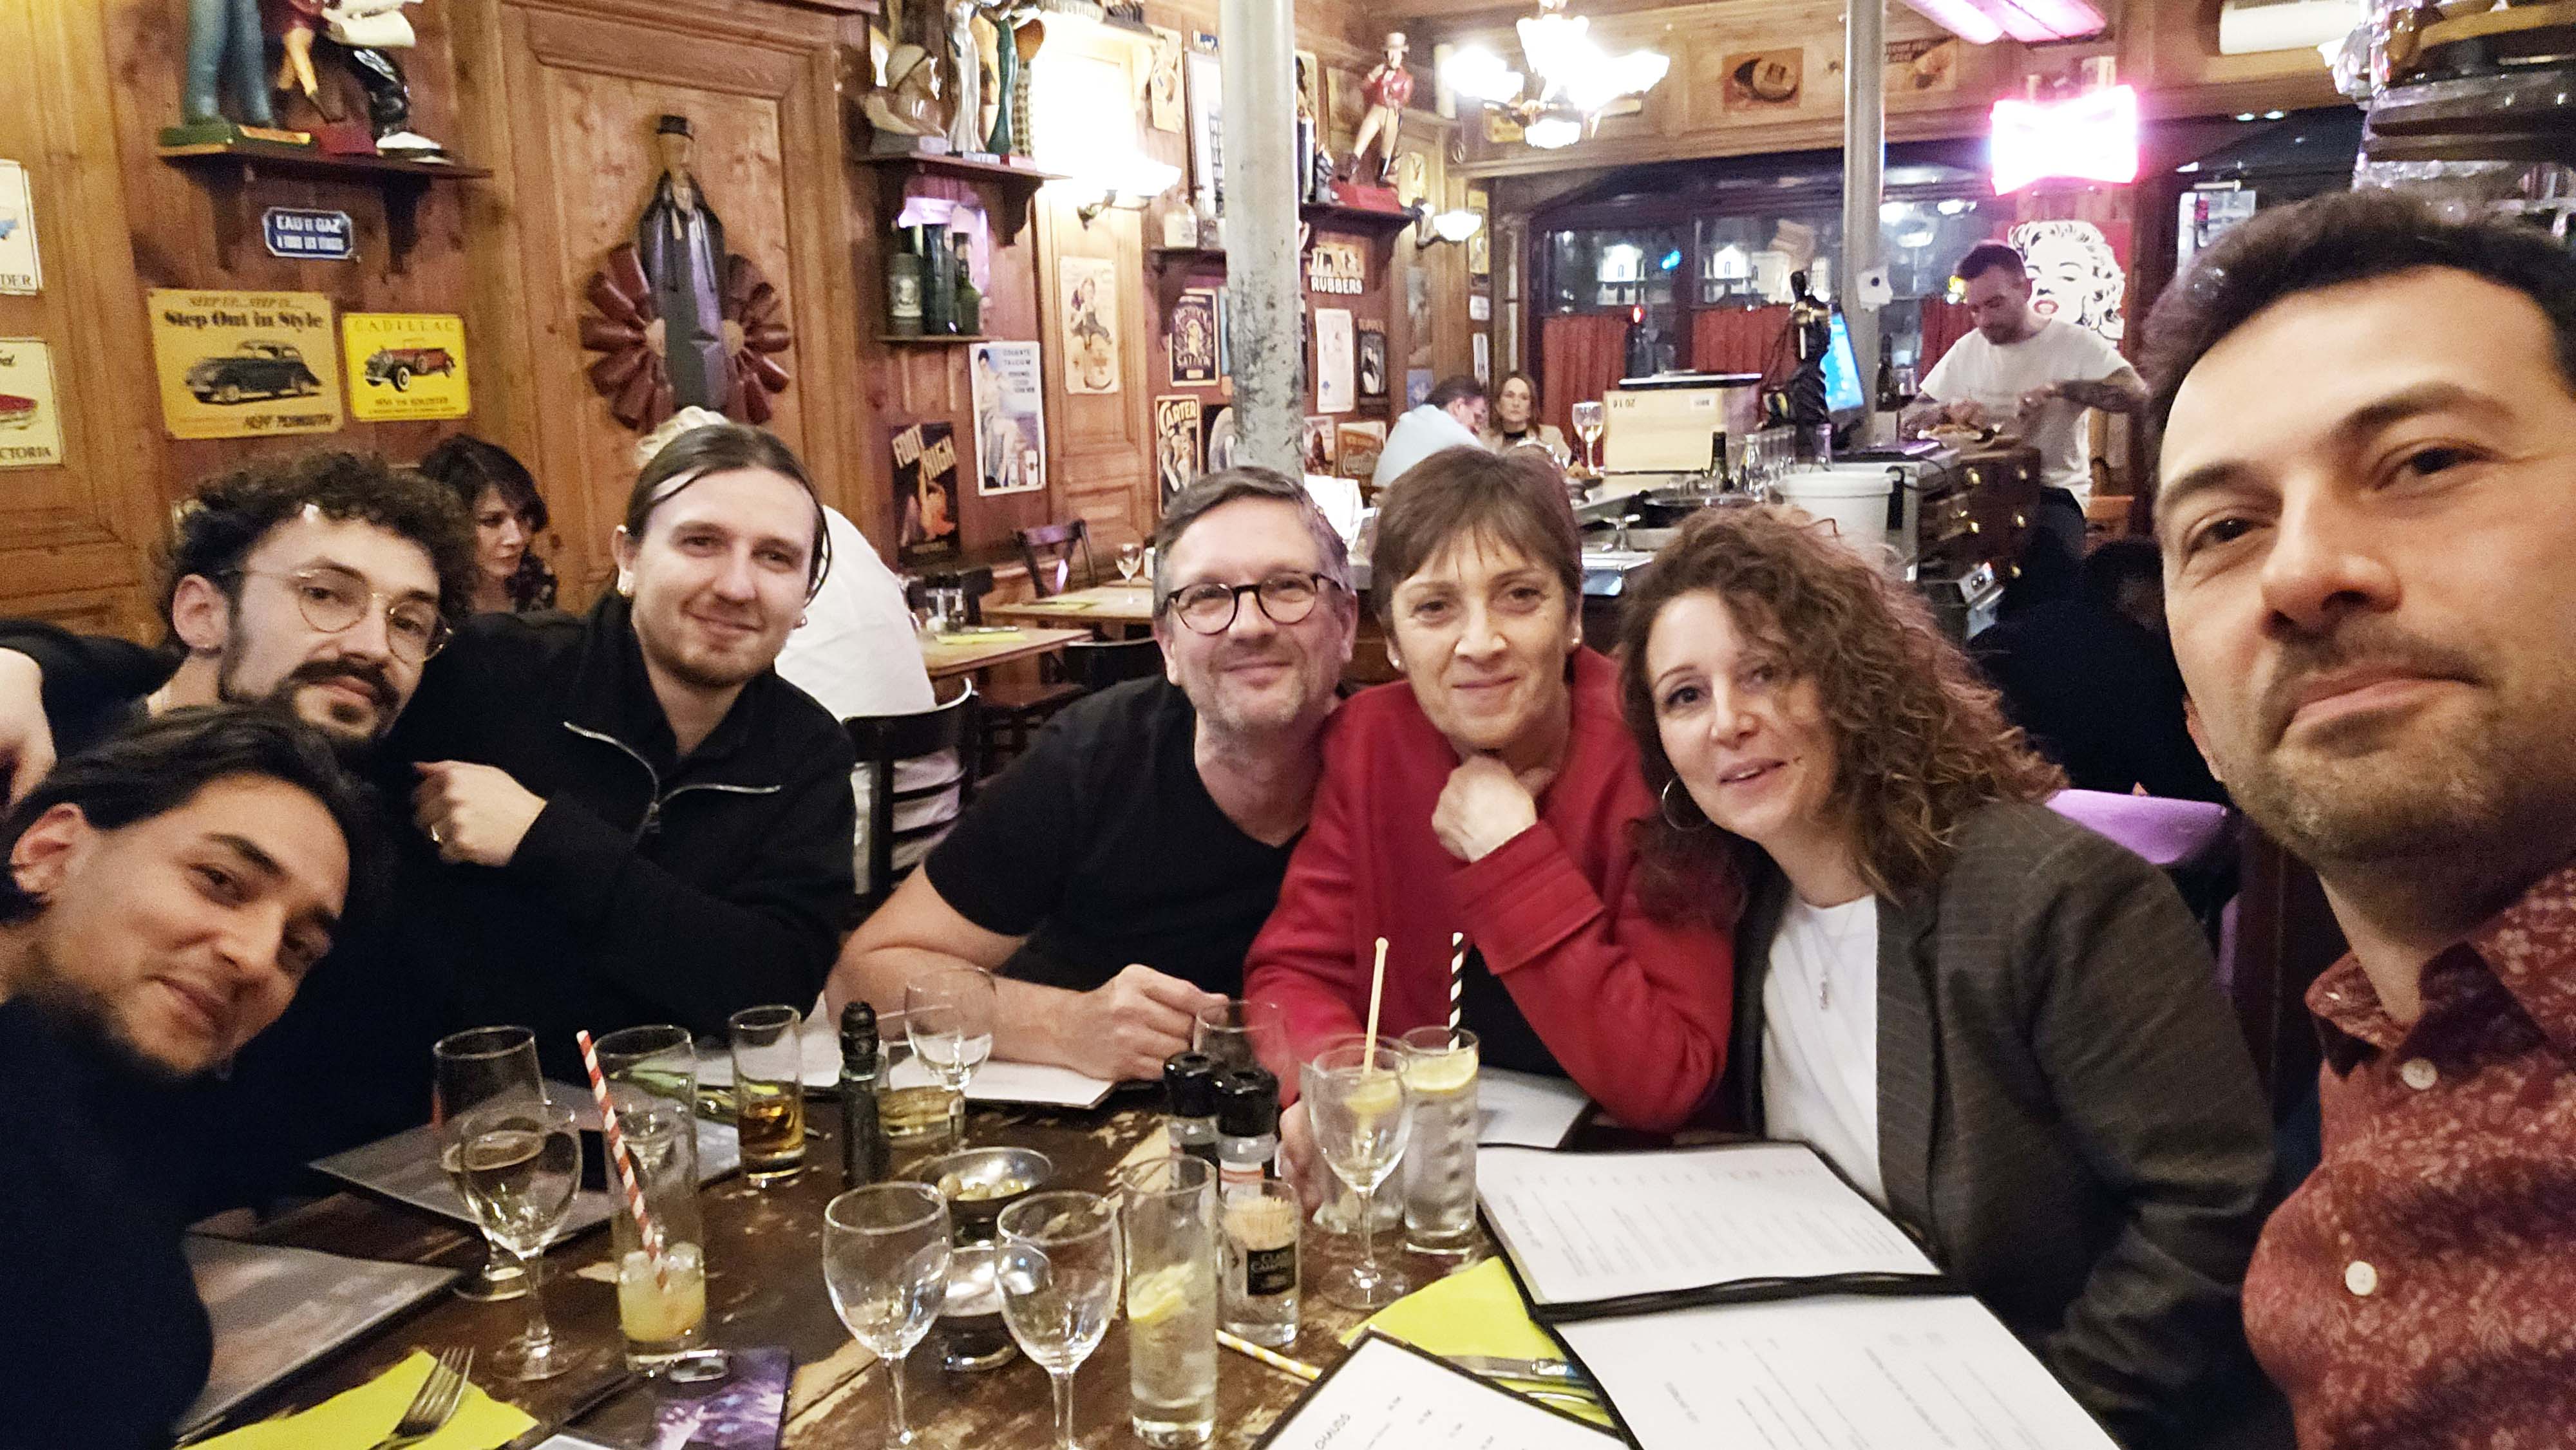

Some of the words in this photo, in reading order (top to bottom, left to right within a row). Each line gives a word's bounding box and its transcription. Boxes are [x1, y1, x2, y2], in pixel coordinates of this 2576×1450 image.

[276, 215, 303, 231] EAU
[315, 217, 343, 234] GAZ
[1311, 277, 1363, 294] RUBBERS
[164, 310, 207, 329] Step
[211, 311, 249, 327] Out
[252, 312, 274, 327] in
[278, 312, 322, 333] Style
[354, 320, 455, 332] CADILLAC
[1159, 401, 1197, 438] CARTER
